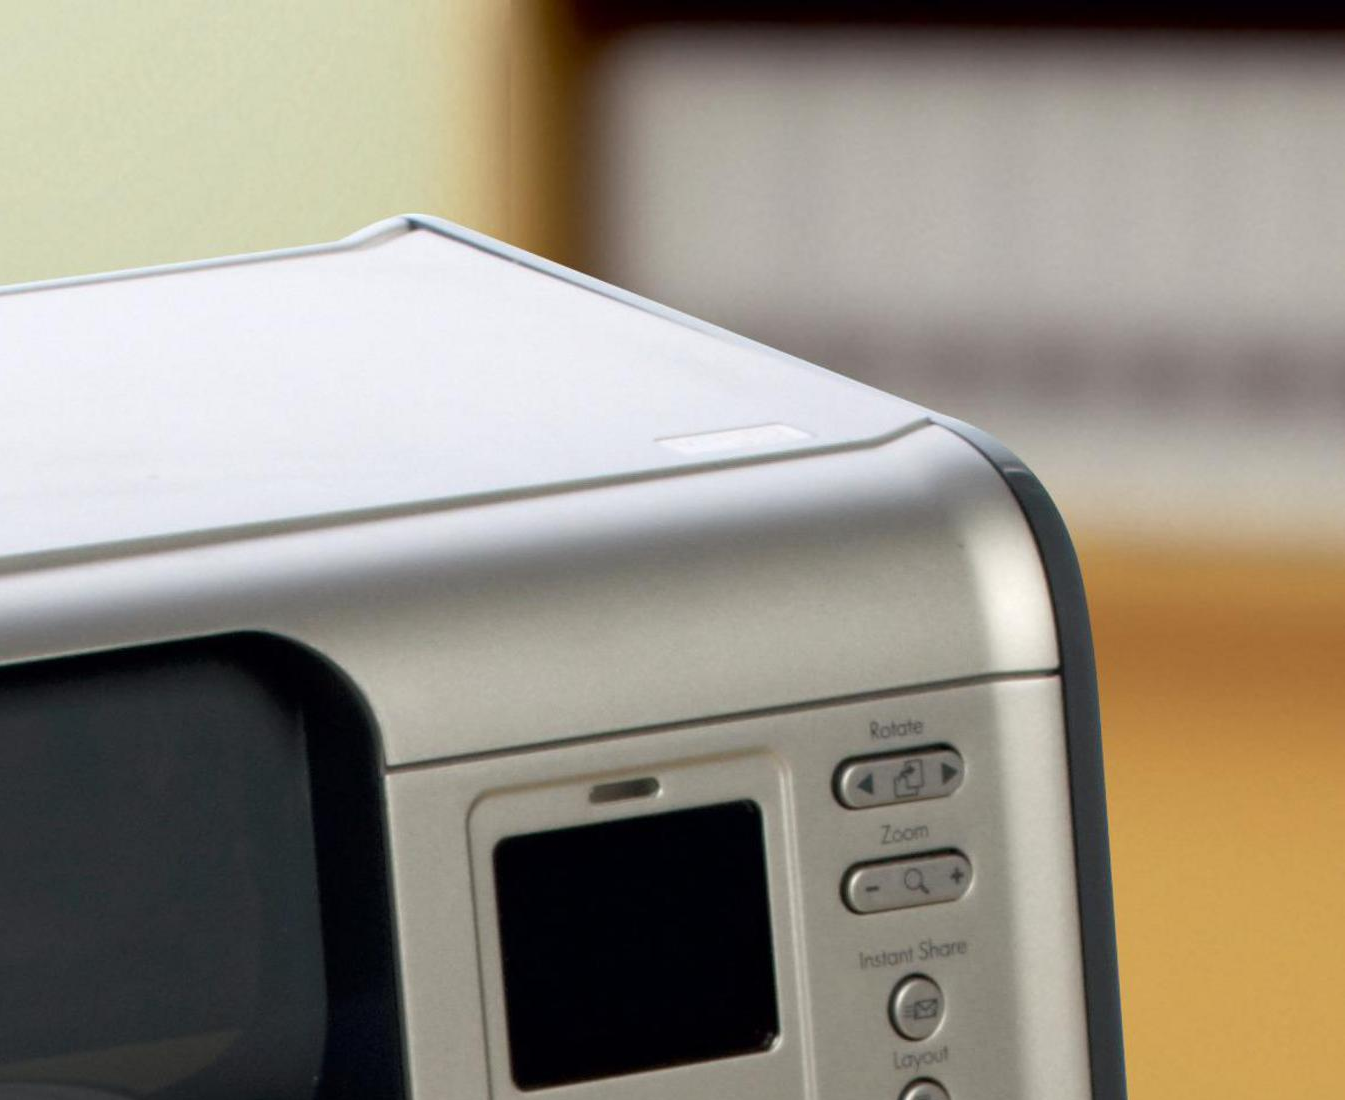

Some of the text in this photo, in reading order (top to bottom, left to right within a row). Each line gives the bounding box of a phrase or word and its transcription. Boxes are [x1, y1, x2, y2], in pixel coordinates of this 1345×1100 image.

[869, 719, 924, 739] Rotate
[880, 824, 929, 845] Zoom
[859, 938, 968, 969] Instant Share
[893, 1046, 949, 1071] Layout
